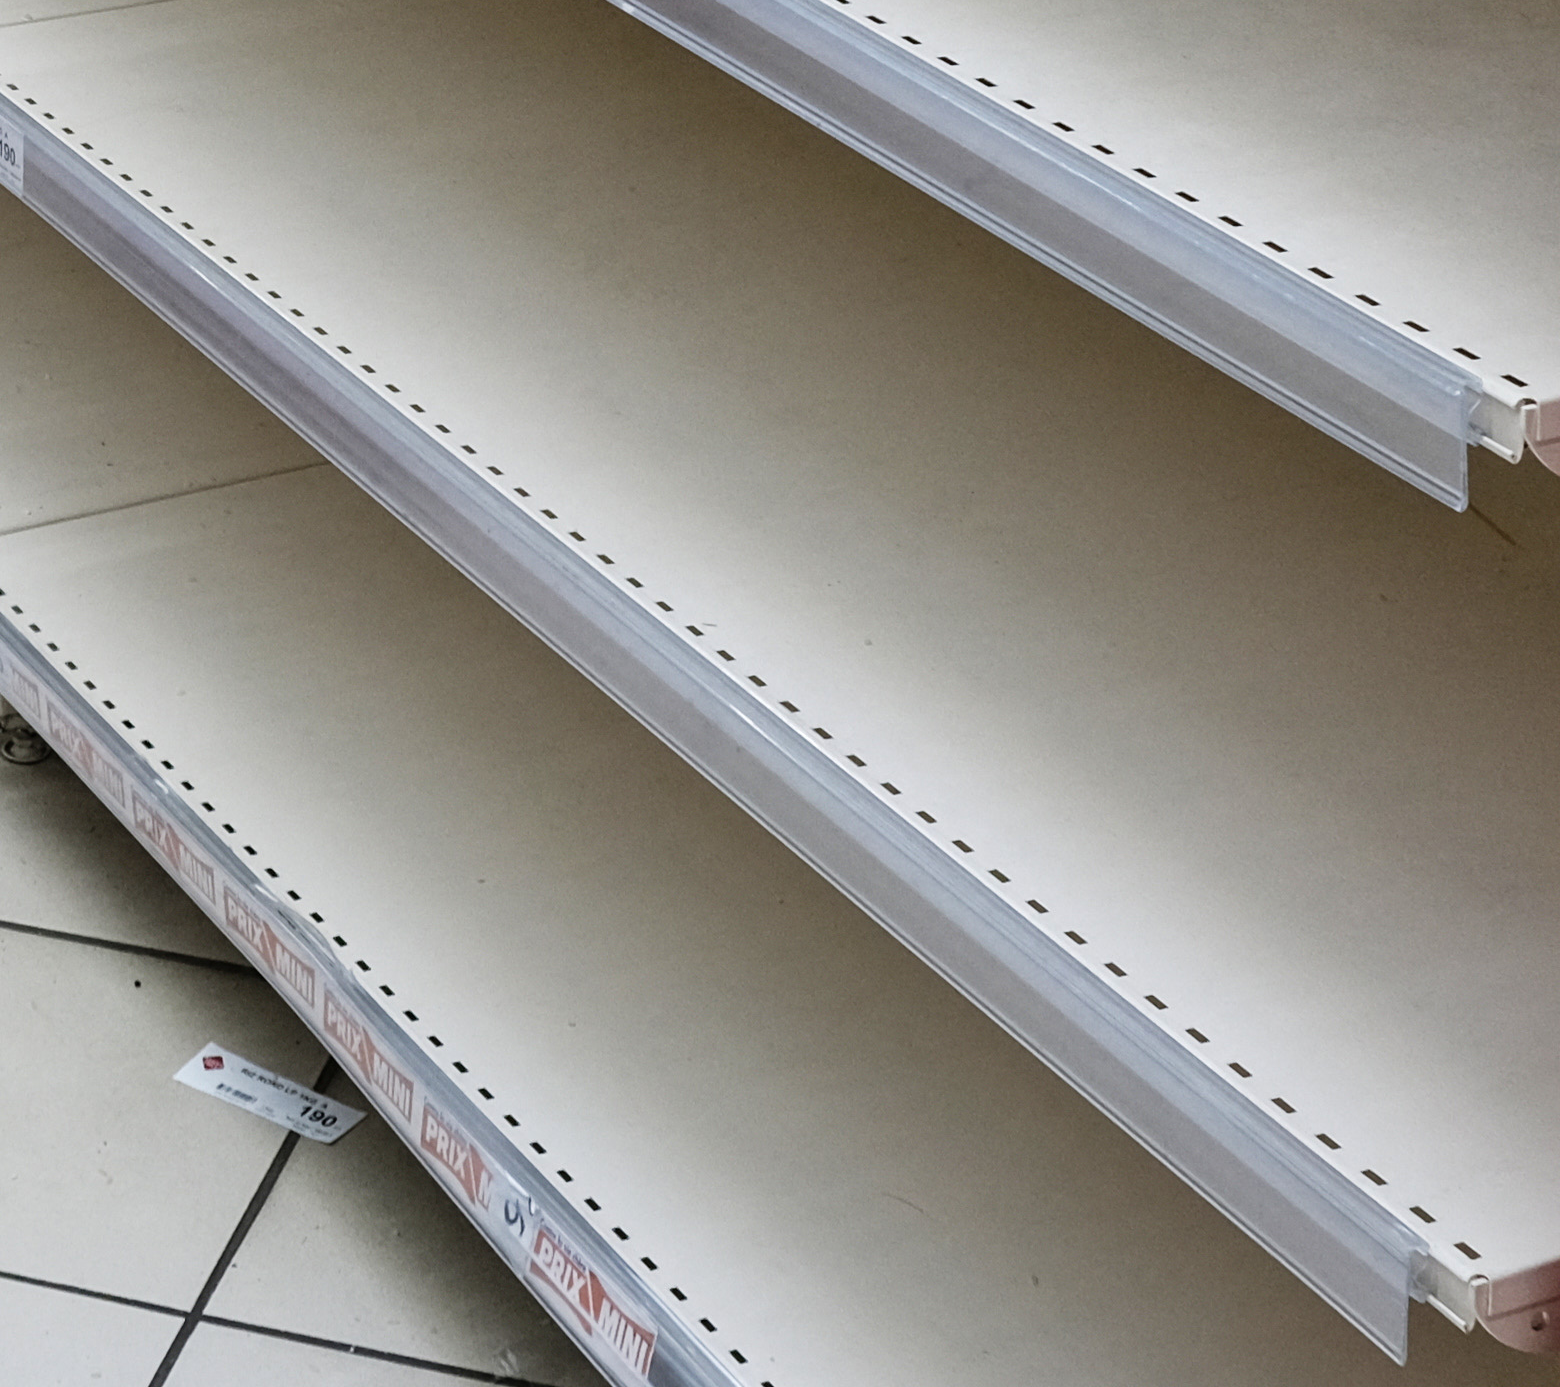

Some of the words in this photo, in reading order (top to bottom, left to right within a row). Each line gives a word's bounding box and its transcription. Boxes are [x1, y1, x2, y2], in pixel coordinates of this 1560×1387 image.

[133, 797, 173, 850] PRIX
[179, 835, 215, 902] MINI
[225, 888, 268, 955] PRIX
[275, 940, 316, 1004] MINI
[326, 1002, 364, 1063] PRIX
[371, 1055, 414, 1119] MINI
[300, 1105, 338, 1128] 190
[424, 1117, 468, 1175] PRIX
[537, 1237, 587, 1302] PRIX
[597, 1305, 652, 1379] MINI
